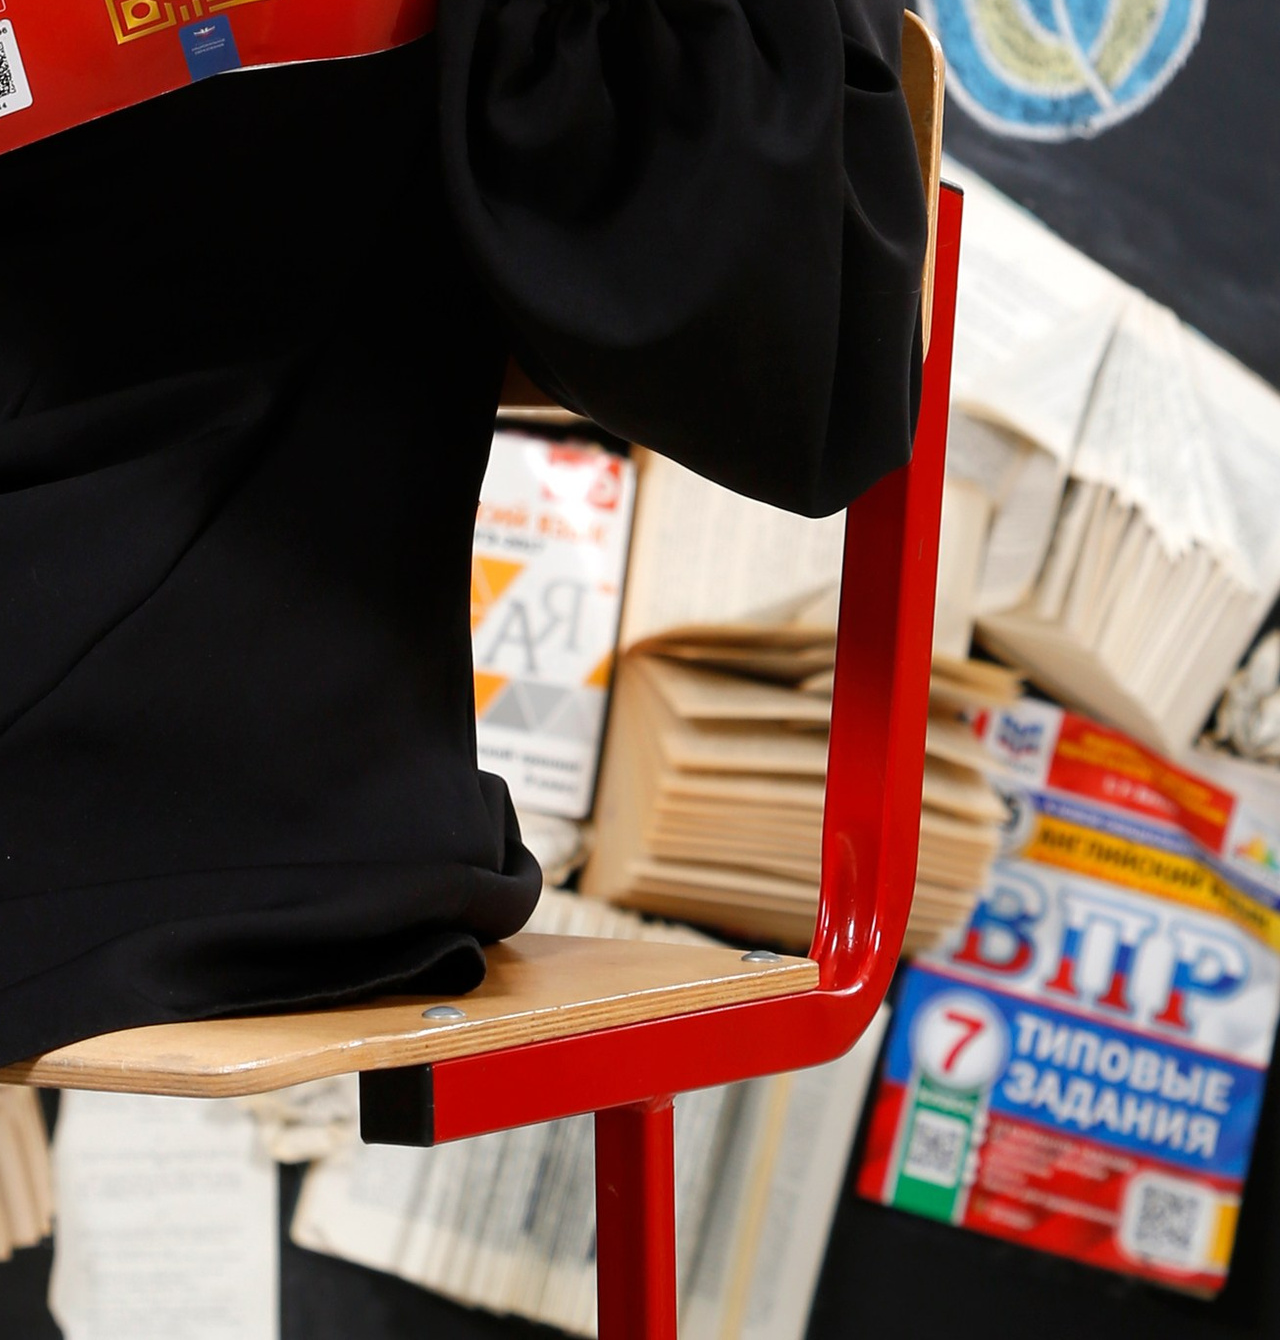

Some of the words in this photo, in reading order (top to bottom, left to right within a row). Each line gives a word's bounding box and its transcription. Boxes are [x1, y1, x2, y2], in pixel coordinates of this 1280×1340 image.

[951, 881, 1248, 1032] ВПР
[943, 1009, 986, 1073] 7
[1016, 1012, 1236, 1116] ТИПОВЫЕ
[1003, 1062, 1222, 1159] ЗАДАНИЯ
